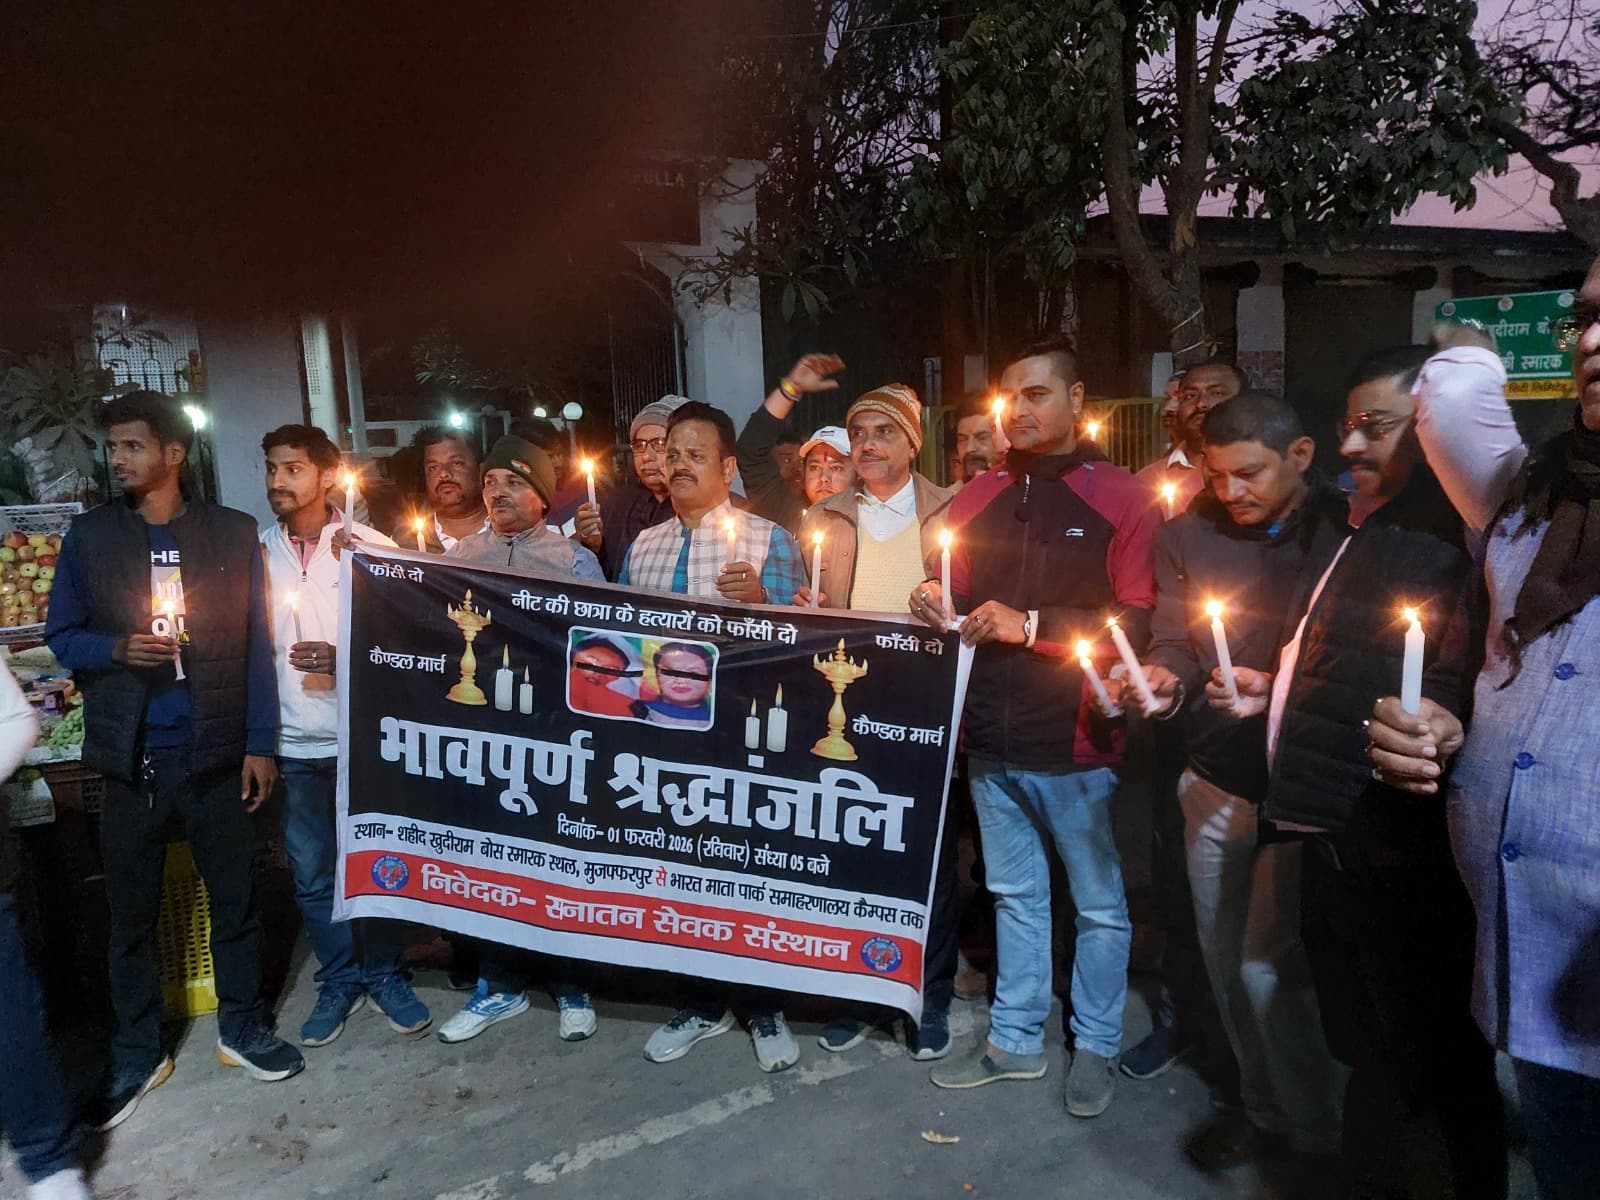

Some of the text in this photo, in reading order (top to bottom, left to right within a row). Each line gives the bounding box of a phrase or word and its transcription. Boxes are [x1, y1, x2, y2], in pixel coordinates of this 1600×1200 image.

[1521, 355, 1562, 369] स्मारक
[408, 567, 424, 583] दो
[511, 589, 799, 645] नीट की छात्रा के हत्यारों को फाँसी दो
[370, 645, 446, 674] कैण्डल मार्च
[875, 633, 944, 655] फाँसी दो
[852, 714, 944, 747] कैण्डल मार्च
[380, 716, 914, 852] भावपूर्ण श्रद्धांजलि
[557, 812, 831, 876] दिनांक- 01 फरवरी 2026 (रविवार) संध्या 05 बजे
[354, 822, 925, 929] स्थान- शहीद खुदीराम बोस स्मारक स्थल, मुजफ्फरपुर से भारत माता पार्क समाहरणालय कैम्पस तक
[420, 863, 537, 908] निवेदक-
[545, 894, 646, 929] सनातन
[652, 905, 736, 943] सेवक
[743, 920, 852, 962] संस्थान
